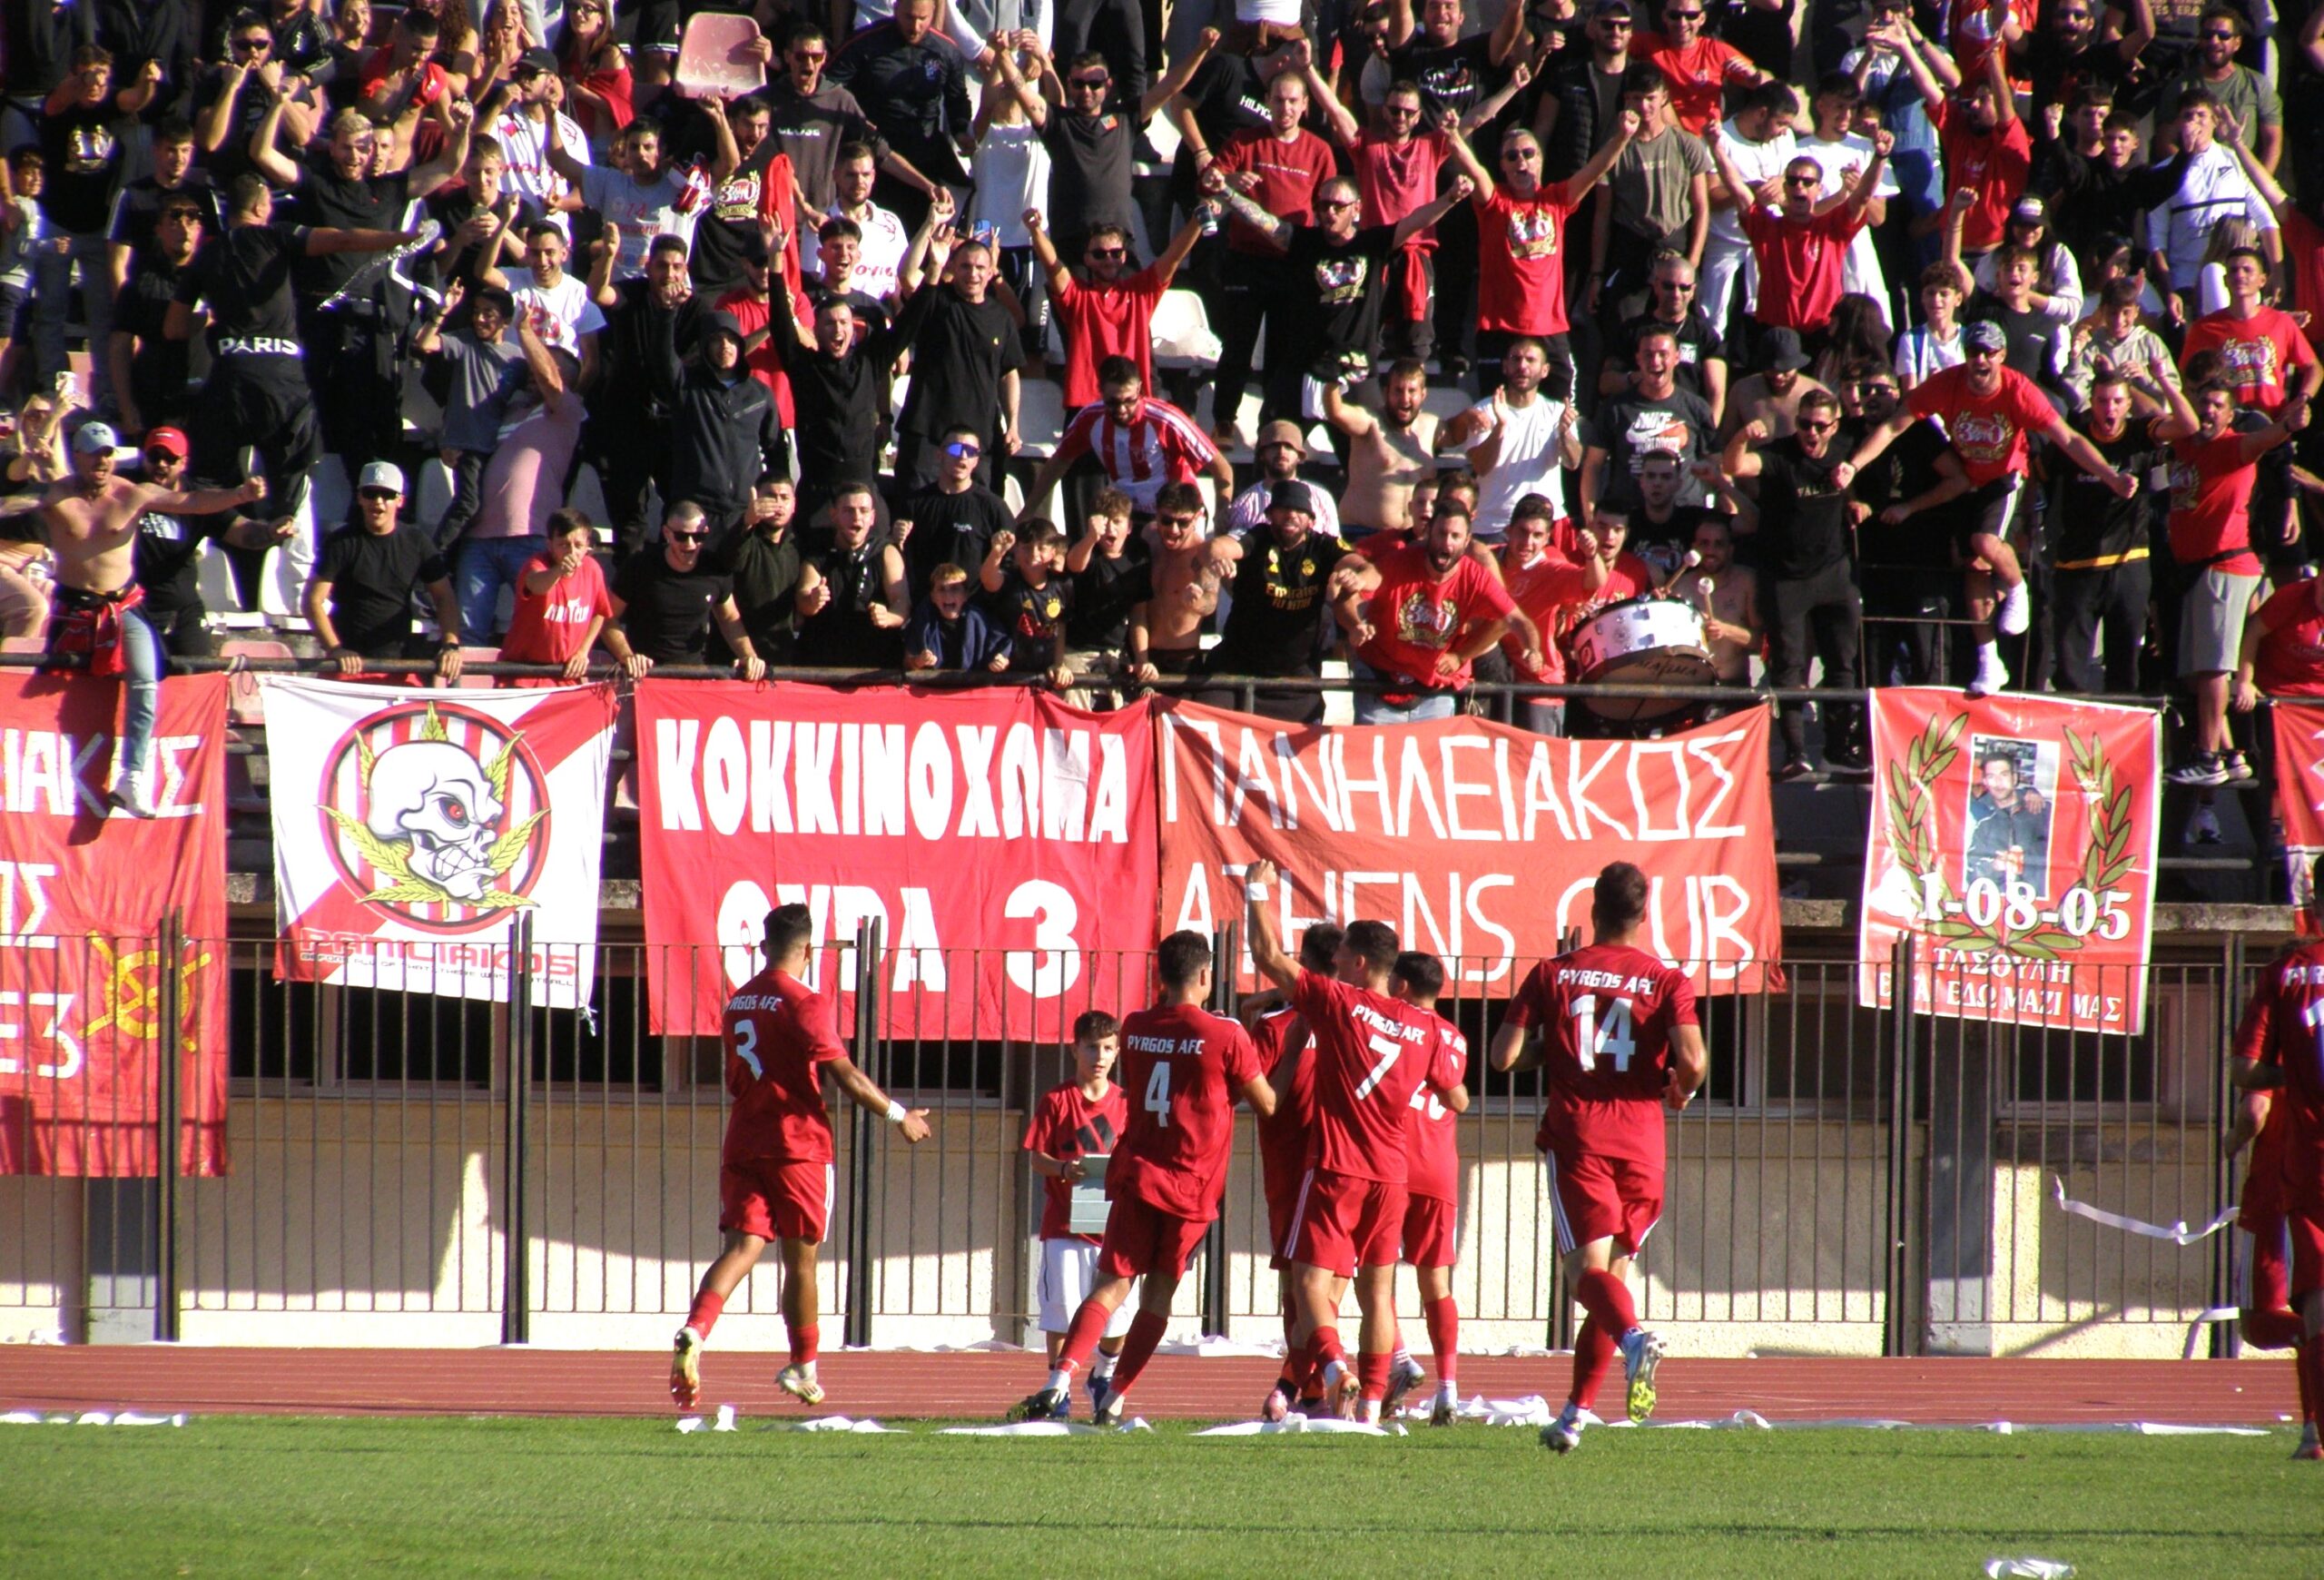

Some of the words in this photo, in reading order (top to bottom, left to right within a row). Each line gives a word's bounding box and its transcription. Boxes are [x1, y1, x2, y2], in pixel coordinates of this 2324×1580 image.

[219, 336, 299, 356] PARIS
[0, 727, 204, 819] ΙΑΚΟΣ
[655, 716, 1128, 844] ΚΟΚΚΙΝΟΧΩΜΑ
[1162, 714, 1746, 843] ΠΑΝΗΛΕΙΑΚΟΣ
[1004, 878, 1079, 999] 3
[1556, 874, 1755, 979] CUB
[1917, 870, 2132, 940] 1-08-05
[728, 994, 759, 1012] RGOS
[758, 995, 783, 1012] AFC
[1557, 968, 1623, 989] PYRGOS
[1623, 976, 1656, 996] AFC
[2073, 992, 2122, 1022] ΜΑΣ
[1128, 1034, 1176, 1054] PYRGOS
[1177, 1039, 1206, 1055] AFC
[1351, 1003, 1403, 1037] PYRGOS
[1400, 1024, 1426, 1046] AFC
[1570, 993, 1636, 1072] 14
[1144, 1061, 1171, 1129] 4
[1354, 1032, 1403, 1101] 7
